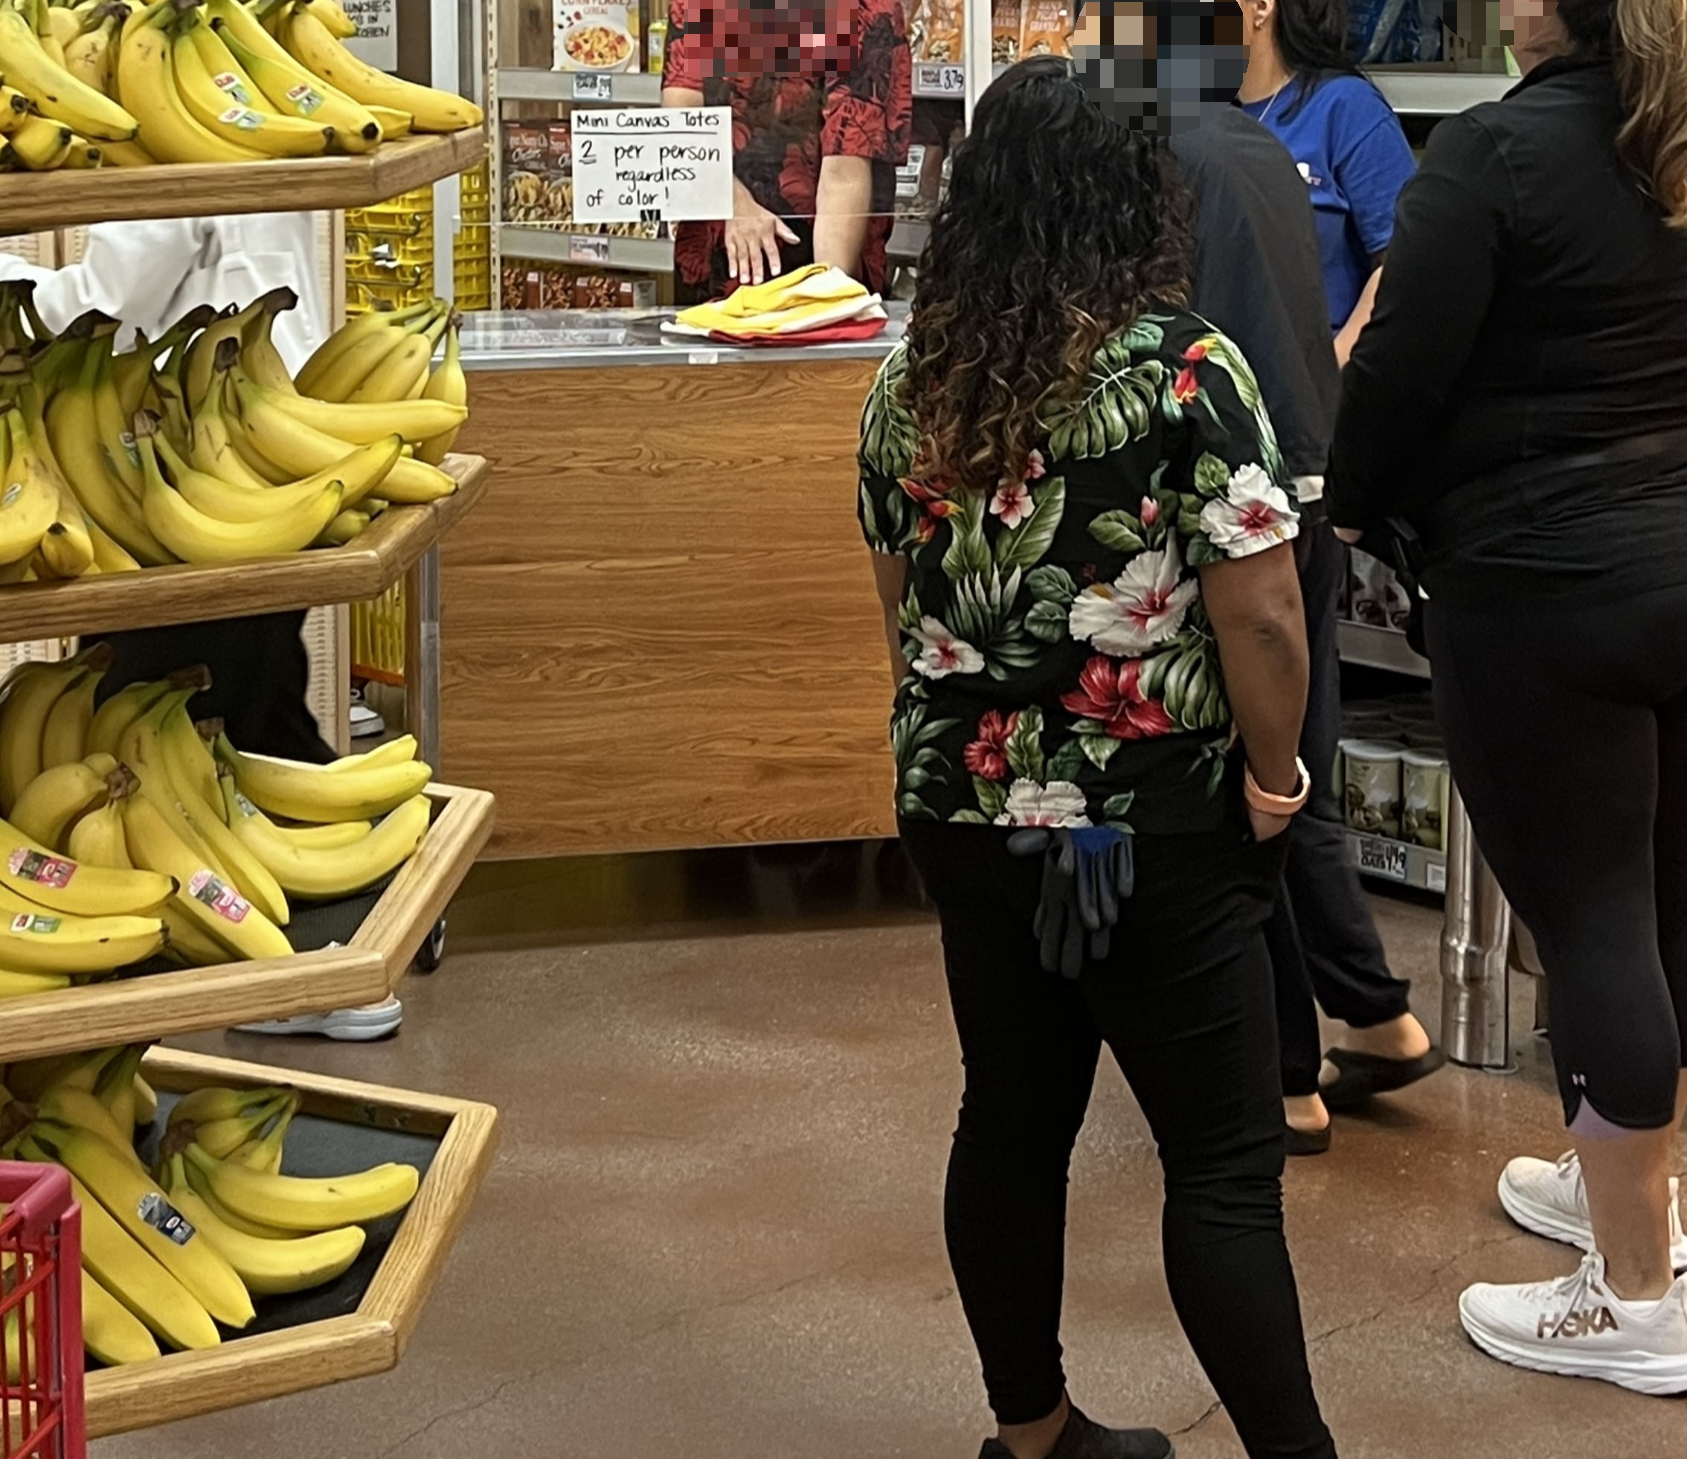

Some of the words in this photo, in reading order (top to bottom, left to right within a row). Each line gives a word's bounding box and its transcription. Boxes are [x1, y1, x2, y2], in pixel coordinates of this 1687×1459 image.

[576, 114, 609, 128] Mini
[615, 112, 670, 128] Canvas
[681, 111, 720, 126] Totes
[580, 140, 597, 159] 2
[614, 144, 644, 167] per
[659, 144, 720, 166] person
[615, 167, 696, 191] regardless
[586, 189, 604, 207] of
[1536, 1306, 1619, 1338] HOKA
